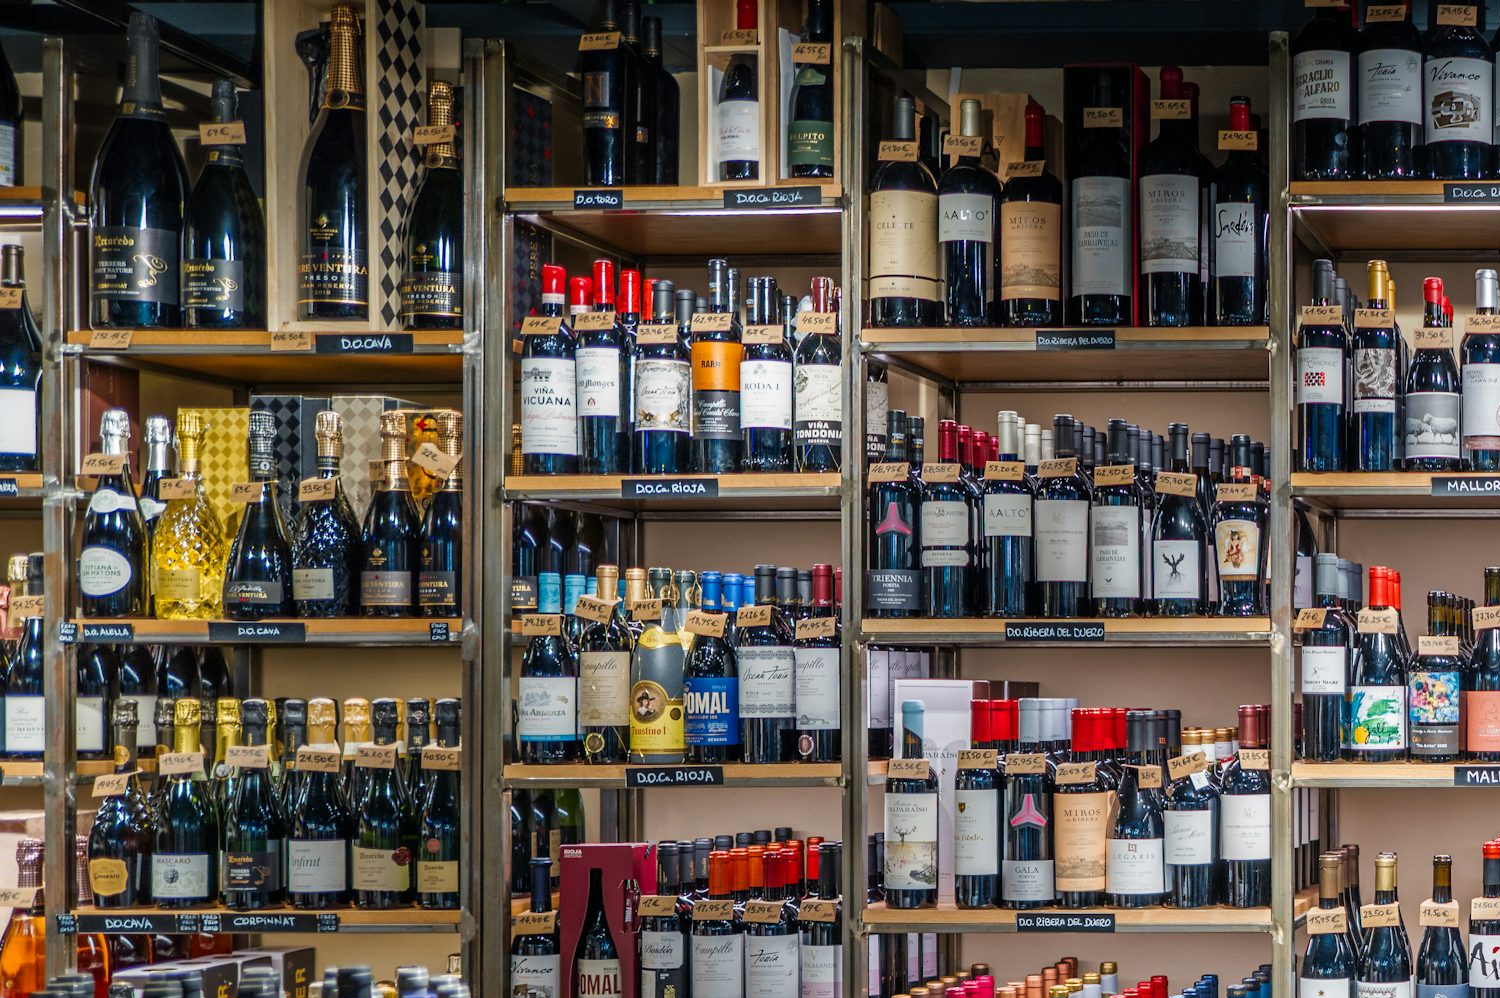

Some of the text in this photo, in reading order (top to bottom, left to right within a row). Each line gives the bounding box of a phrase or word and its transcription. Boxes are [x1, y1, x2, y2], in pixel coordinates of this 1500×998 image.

[1304, 82, 1340, 96] ALFARO
[944, 210, 986, 222] AALTO
[311, 262, 368, 276] VENTURA
[411, 283, 455, 293] VENTURA
[808, 421, 828, 430] VIÑA
[989, 507, 1026, 518] AALTO
[676, 771, 713, 782] RIOJA
[1064, 808, 1101, 817] MIROS
[1015, 866, 1039, 874] GALA
